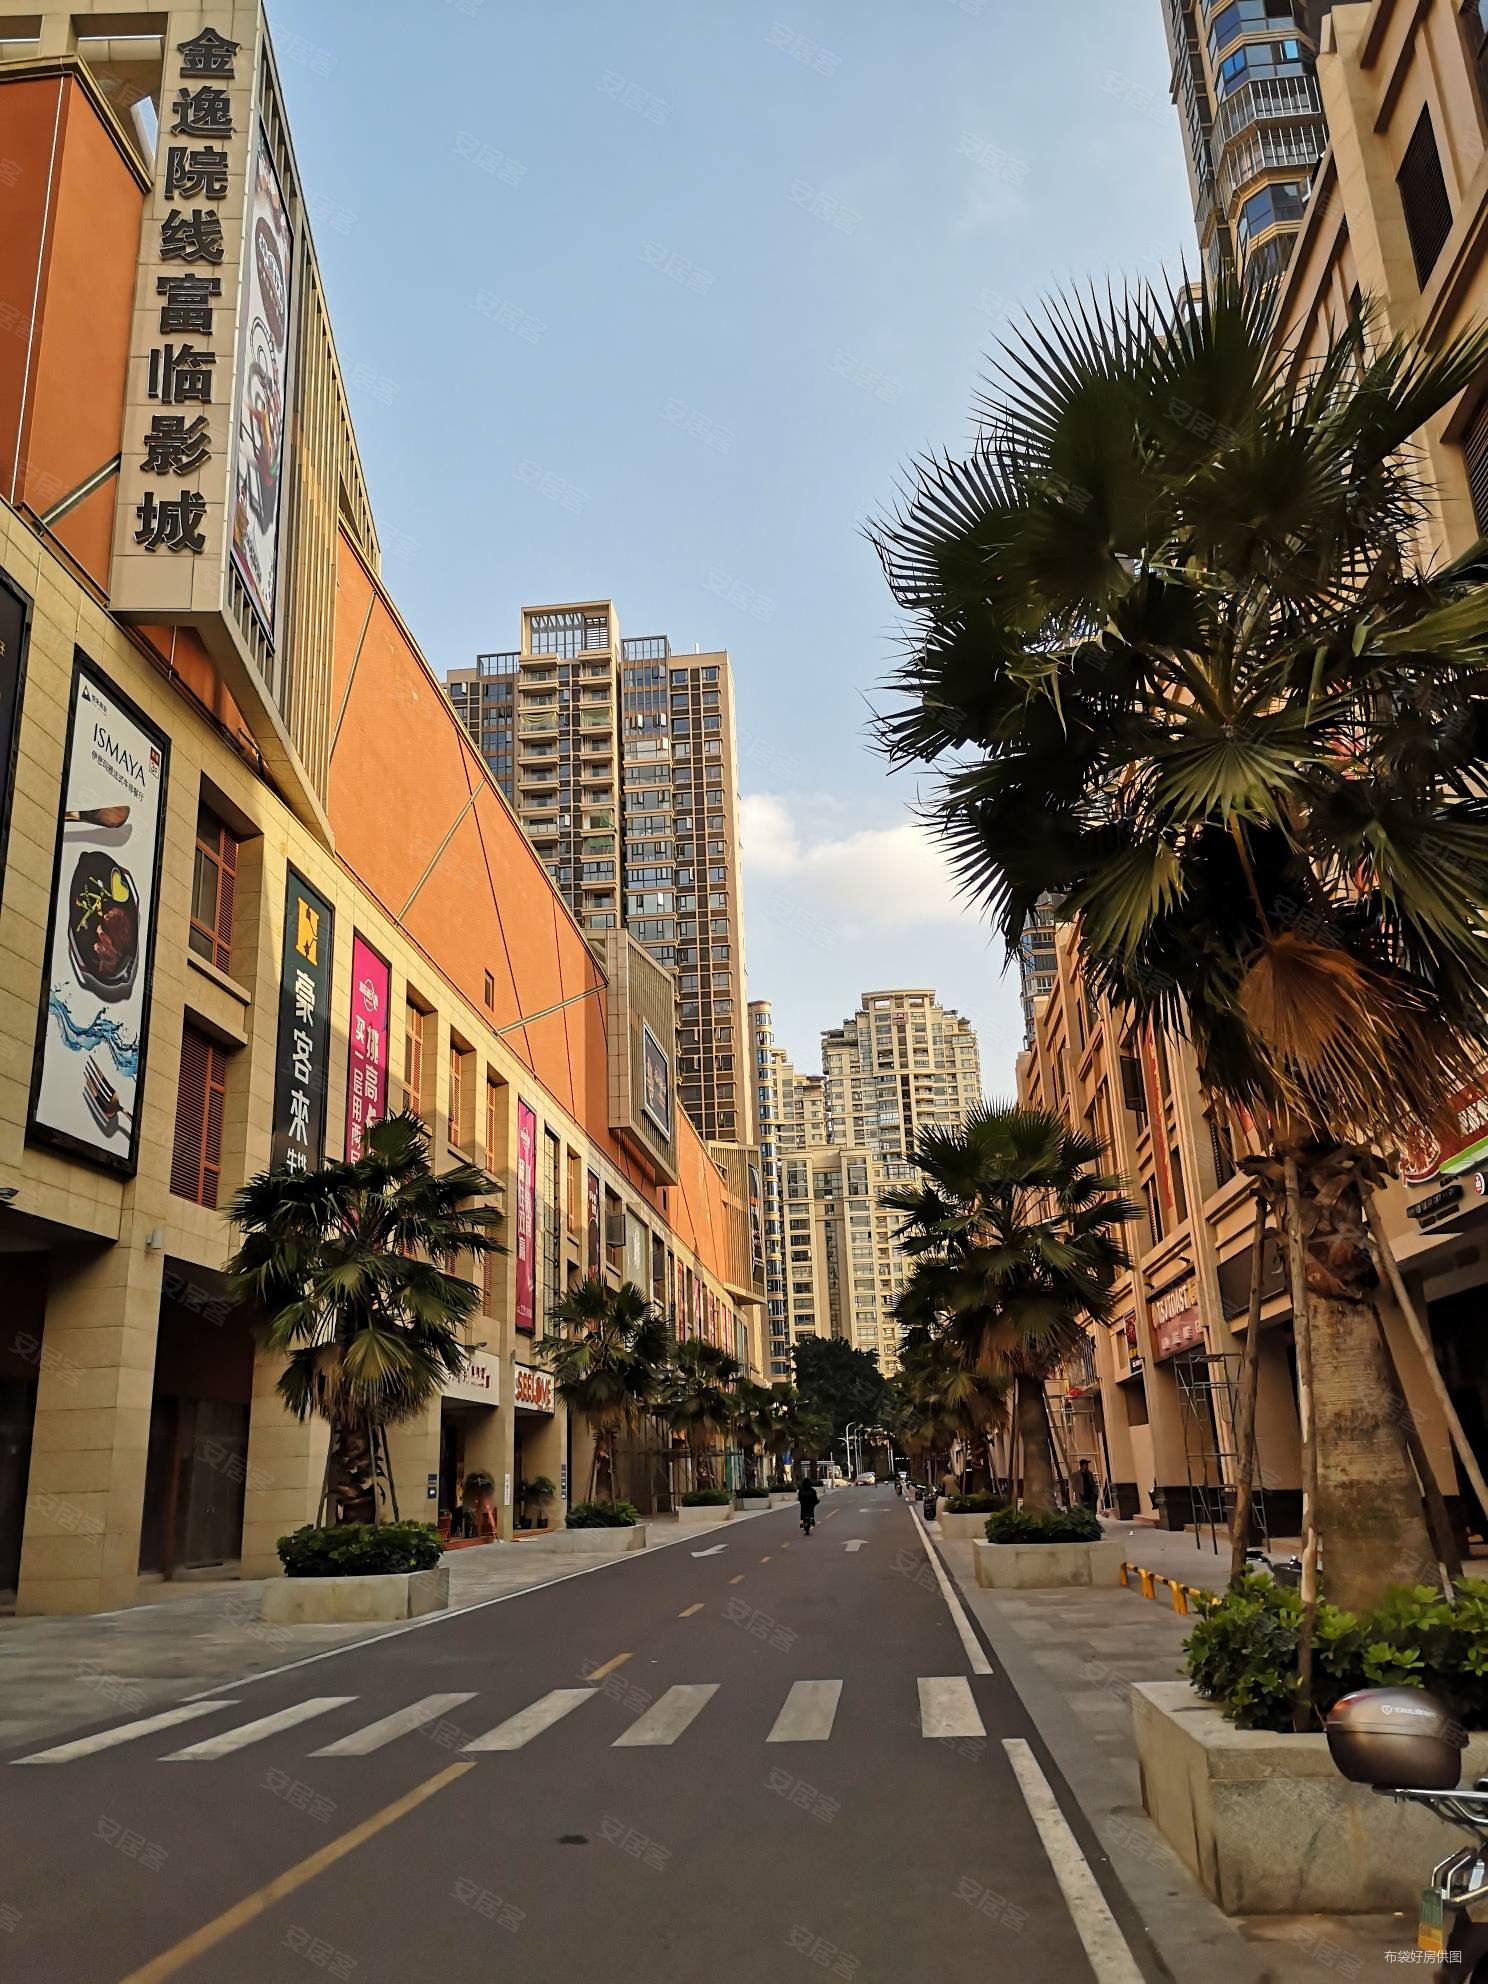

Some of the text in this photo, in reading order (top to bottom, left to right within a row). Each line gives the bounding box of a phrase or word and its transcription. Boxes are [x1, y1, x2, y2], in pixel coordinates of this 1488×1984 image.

[133, 26, 241, 555] 金逸院线富临影城
[93, 723, 146, 787] ISMAYA
